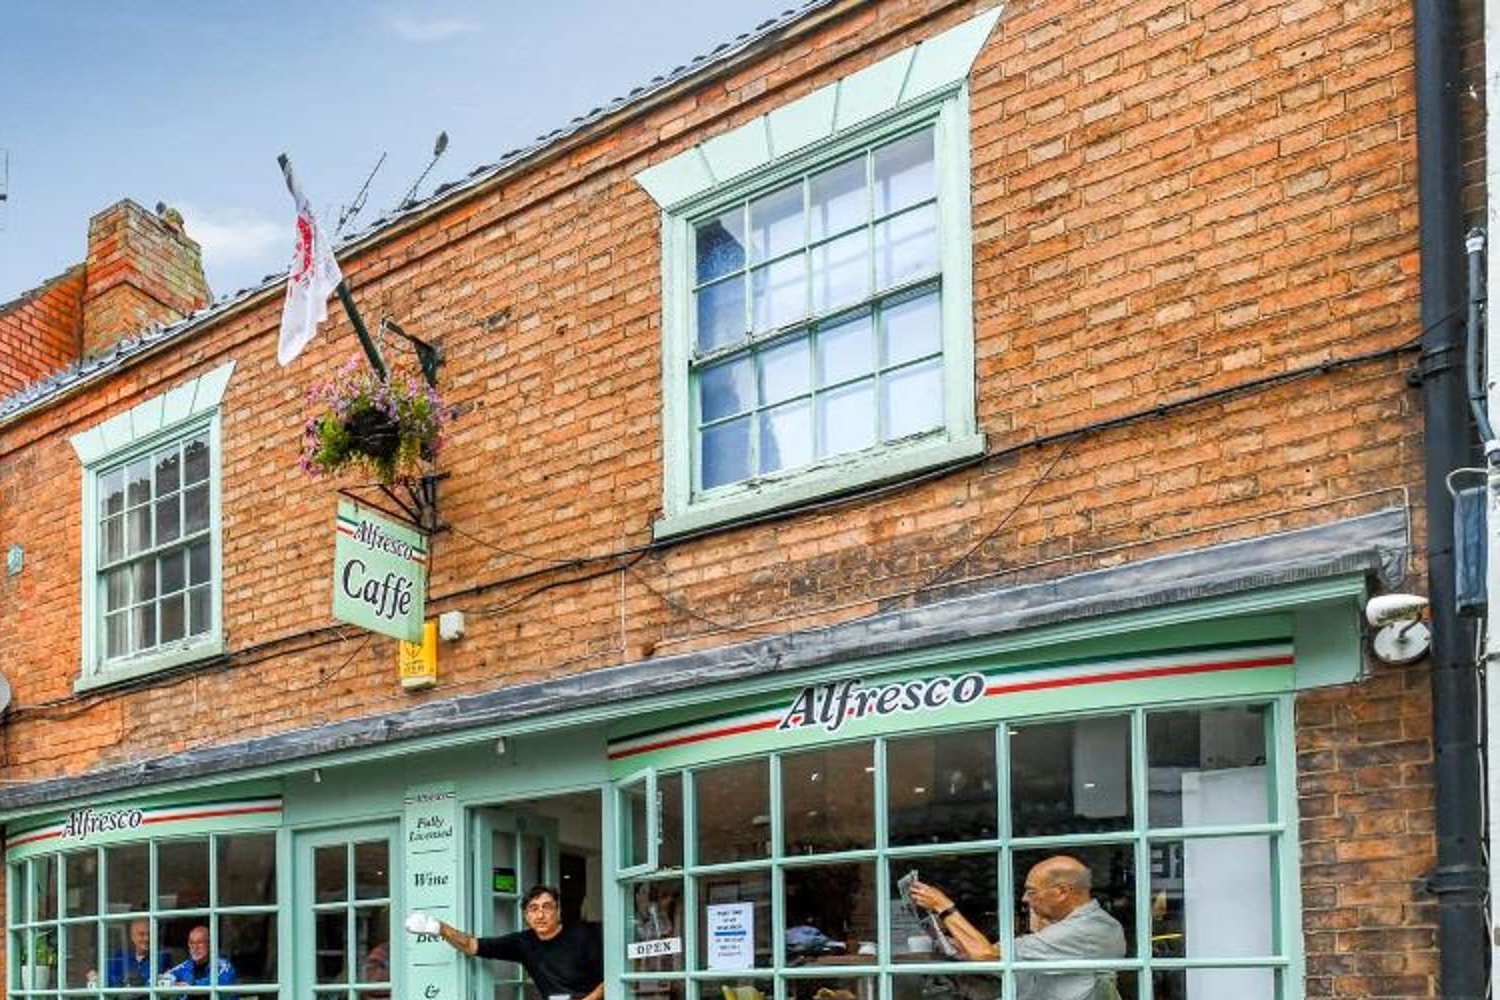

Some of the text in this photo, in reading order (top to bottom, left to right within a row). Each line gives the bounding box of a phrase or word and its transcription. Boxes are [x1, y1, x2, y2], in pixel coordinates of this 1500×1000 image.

[353, 519, 413, 561] Alfresco
[343, 559, 413, 620] Caffé
[779, 674, 986, 732] Alfresco
[62, 807, 143, 841] Alfresco
[417, 816, 444, 829] Fully
[409, 826, 452, 842] Licensed
[414, 873, 449, 887] Wine
[637, 940, 671, 955] OPEN
[424, 984, 440, 999] &
